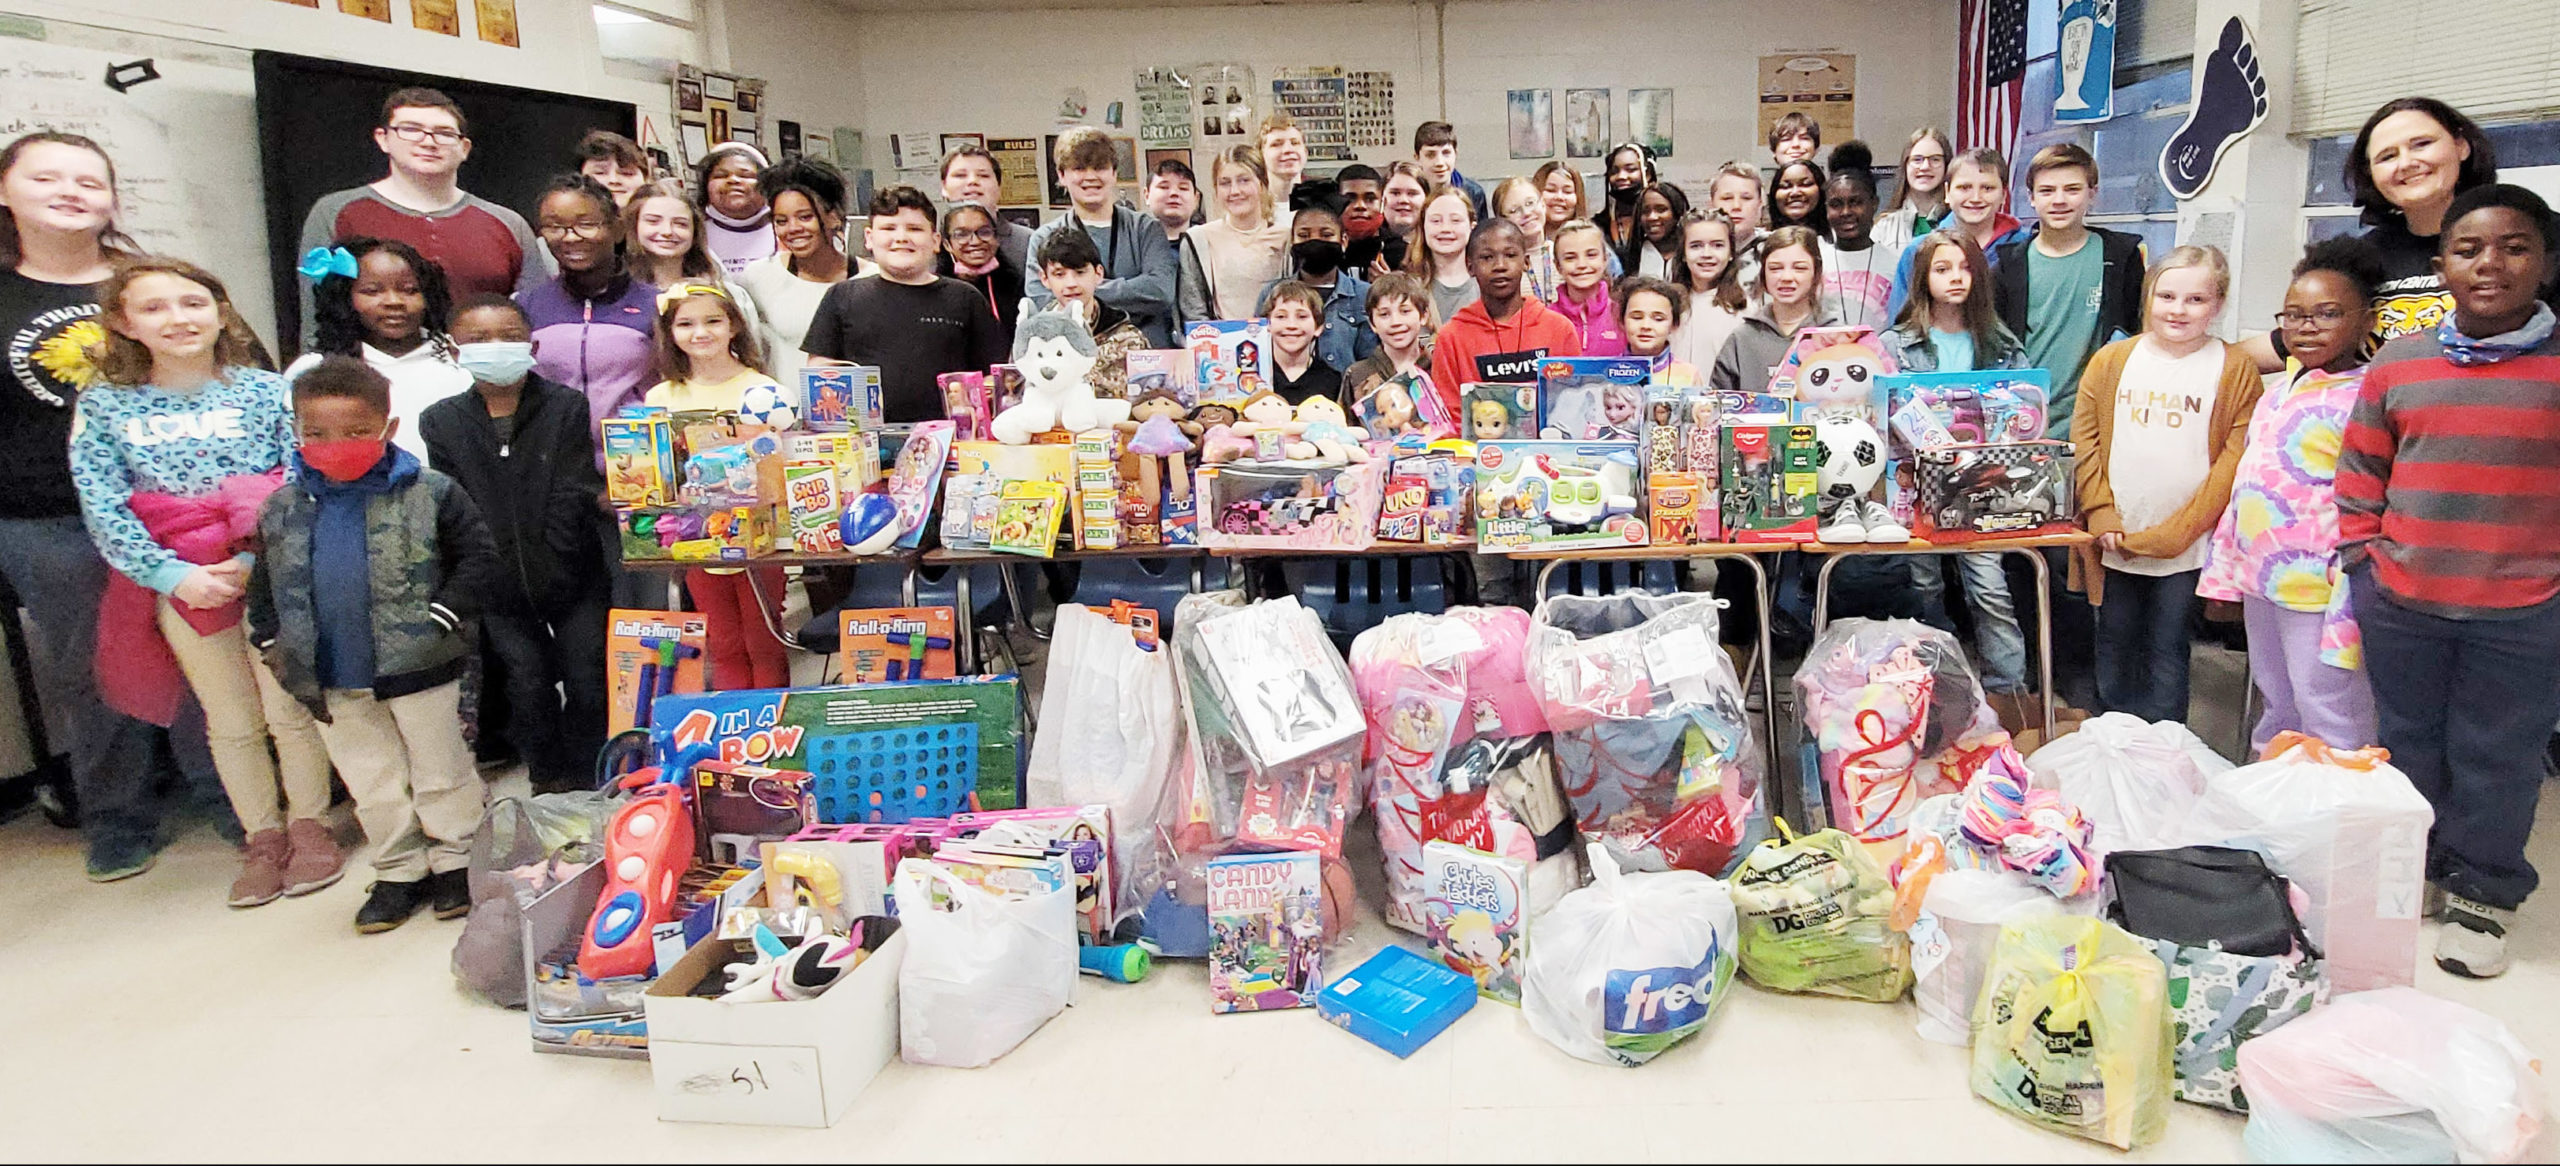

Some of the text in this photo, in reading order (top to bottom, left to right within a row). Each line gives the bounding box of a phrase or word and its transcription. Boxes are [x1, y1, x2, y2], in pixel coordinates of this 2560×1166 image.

[1004, 140, 1035, 149] RULES
[1141, 125, 1191, 140] DREAMS
[1608, 368, 1640, 377] FROZEN
[2118, 389, 2201, 413] HUMAN
[127, 408, 246, 446] LOVE
[2131, 407, 2183, 428] KIND
[805, 493, 830, 513] BO
[1177, 500, 1190, 511] 10
[1385, 487, 1426, 513] UNO
[1484, 534, 1532, 546] People
[1487, 521, 1527, 535] Little
[719, 704, 778, 735] IN A
[719, 726, 804, 764] ROW
[1209, 862, 1293, 888] CANDY
[1443, 861, 1496, 891] Chutes
[1210, 886, 1273, 912] LAND
[1443, 879, 1500, 913] Ladders
[1772, 913, 1805, 933] DG
[1622, 953, 1716, 1030] fred
